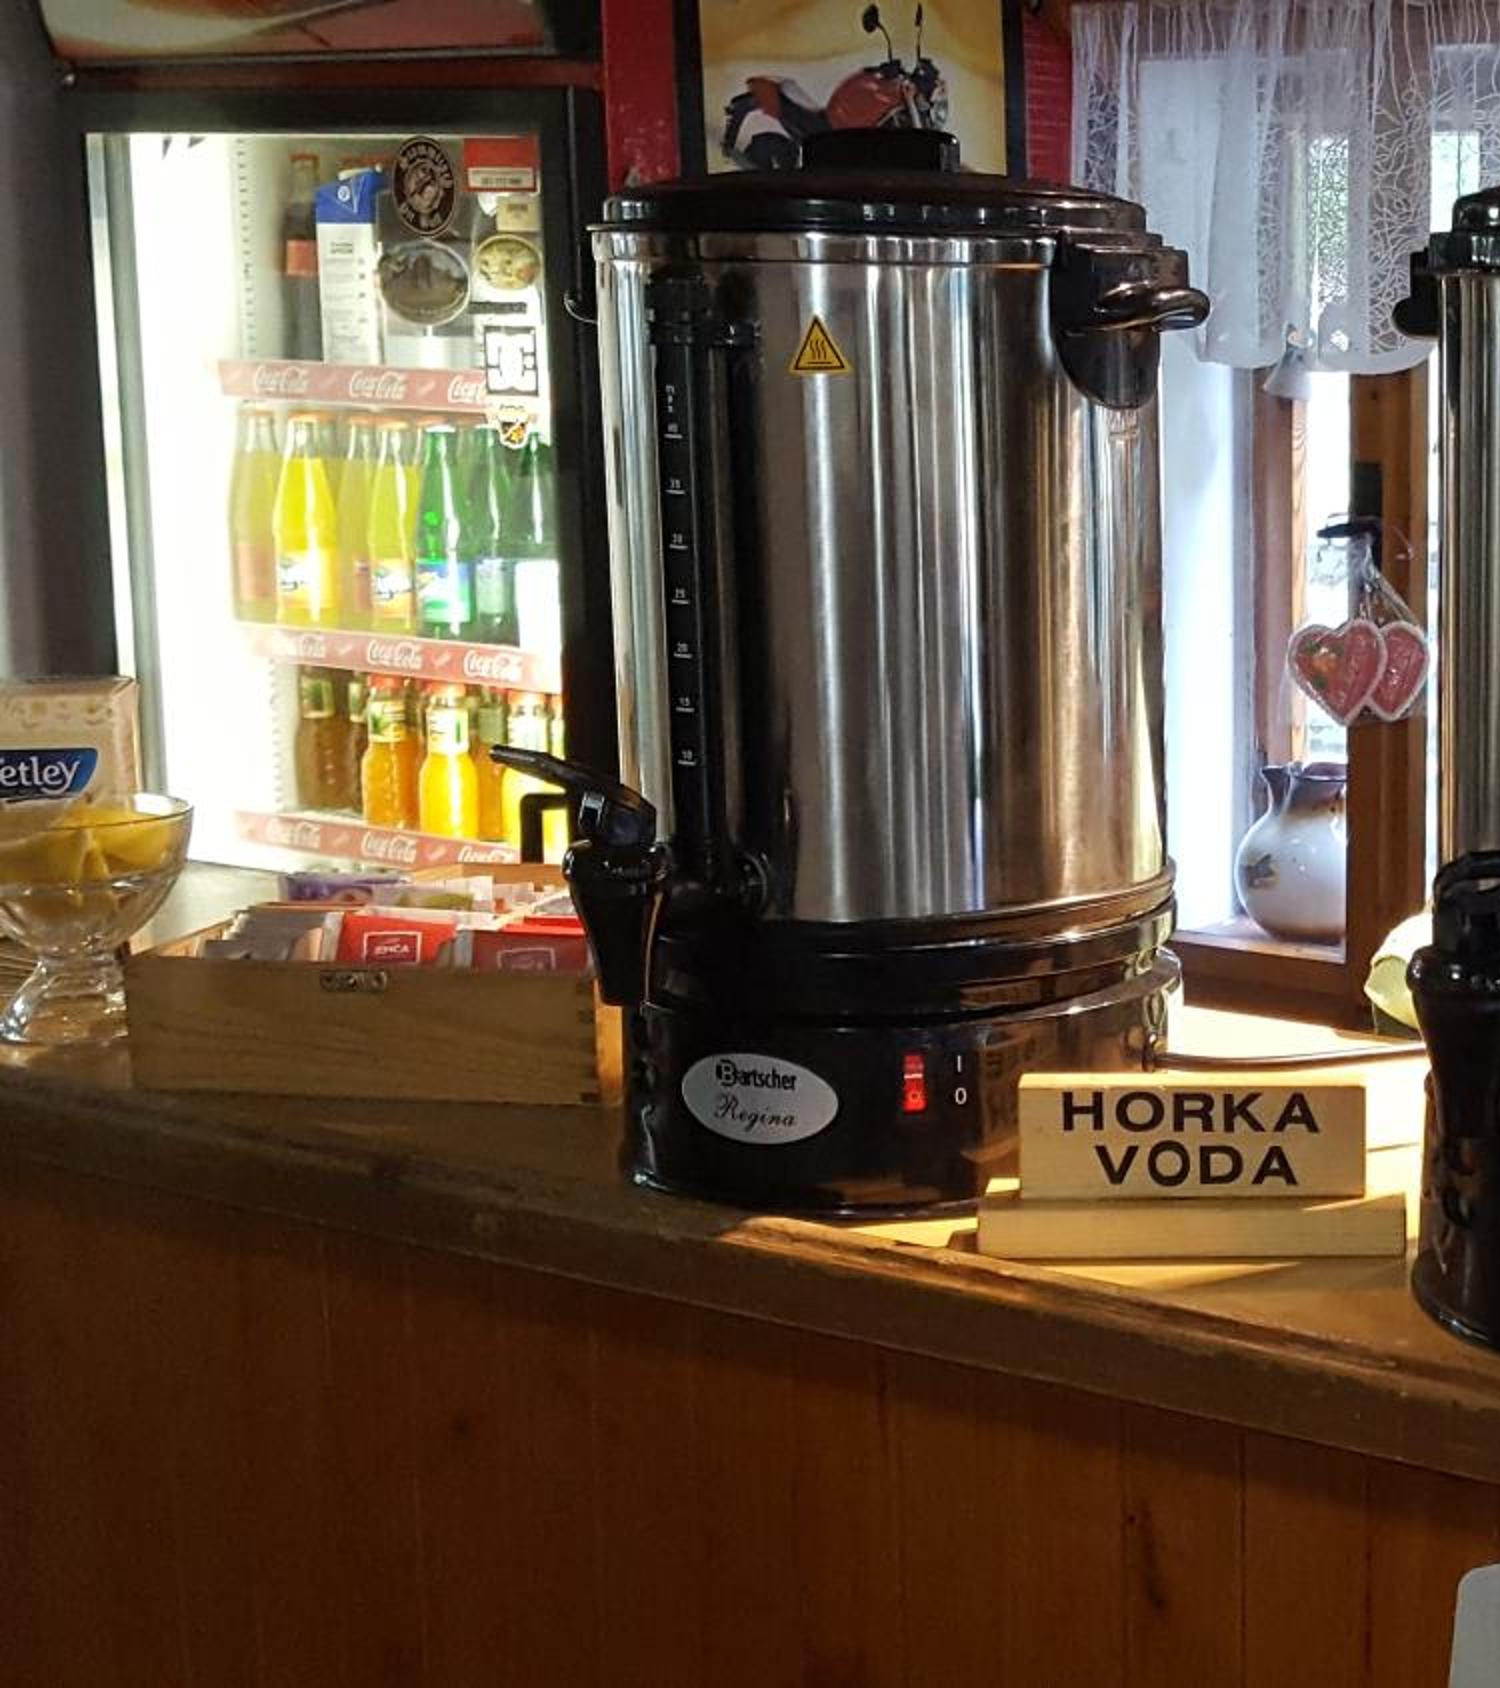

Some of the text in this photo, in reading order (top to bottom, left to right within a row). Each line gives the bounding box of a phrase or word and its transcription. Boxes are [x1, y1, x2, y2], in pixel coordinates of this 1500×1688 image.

[0, 755, 80, 795] etley
[716, 1059, 797, 1091] Bartscher
[713, 1092, 796, 1130] Regina
[1062, 1091, 1320, 1133] HORKA
[1095, 1139, 1299, 1187] VODA
